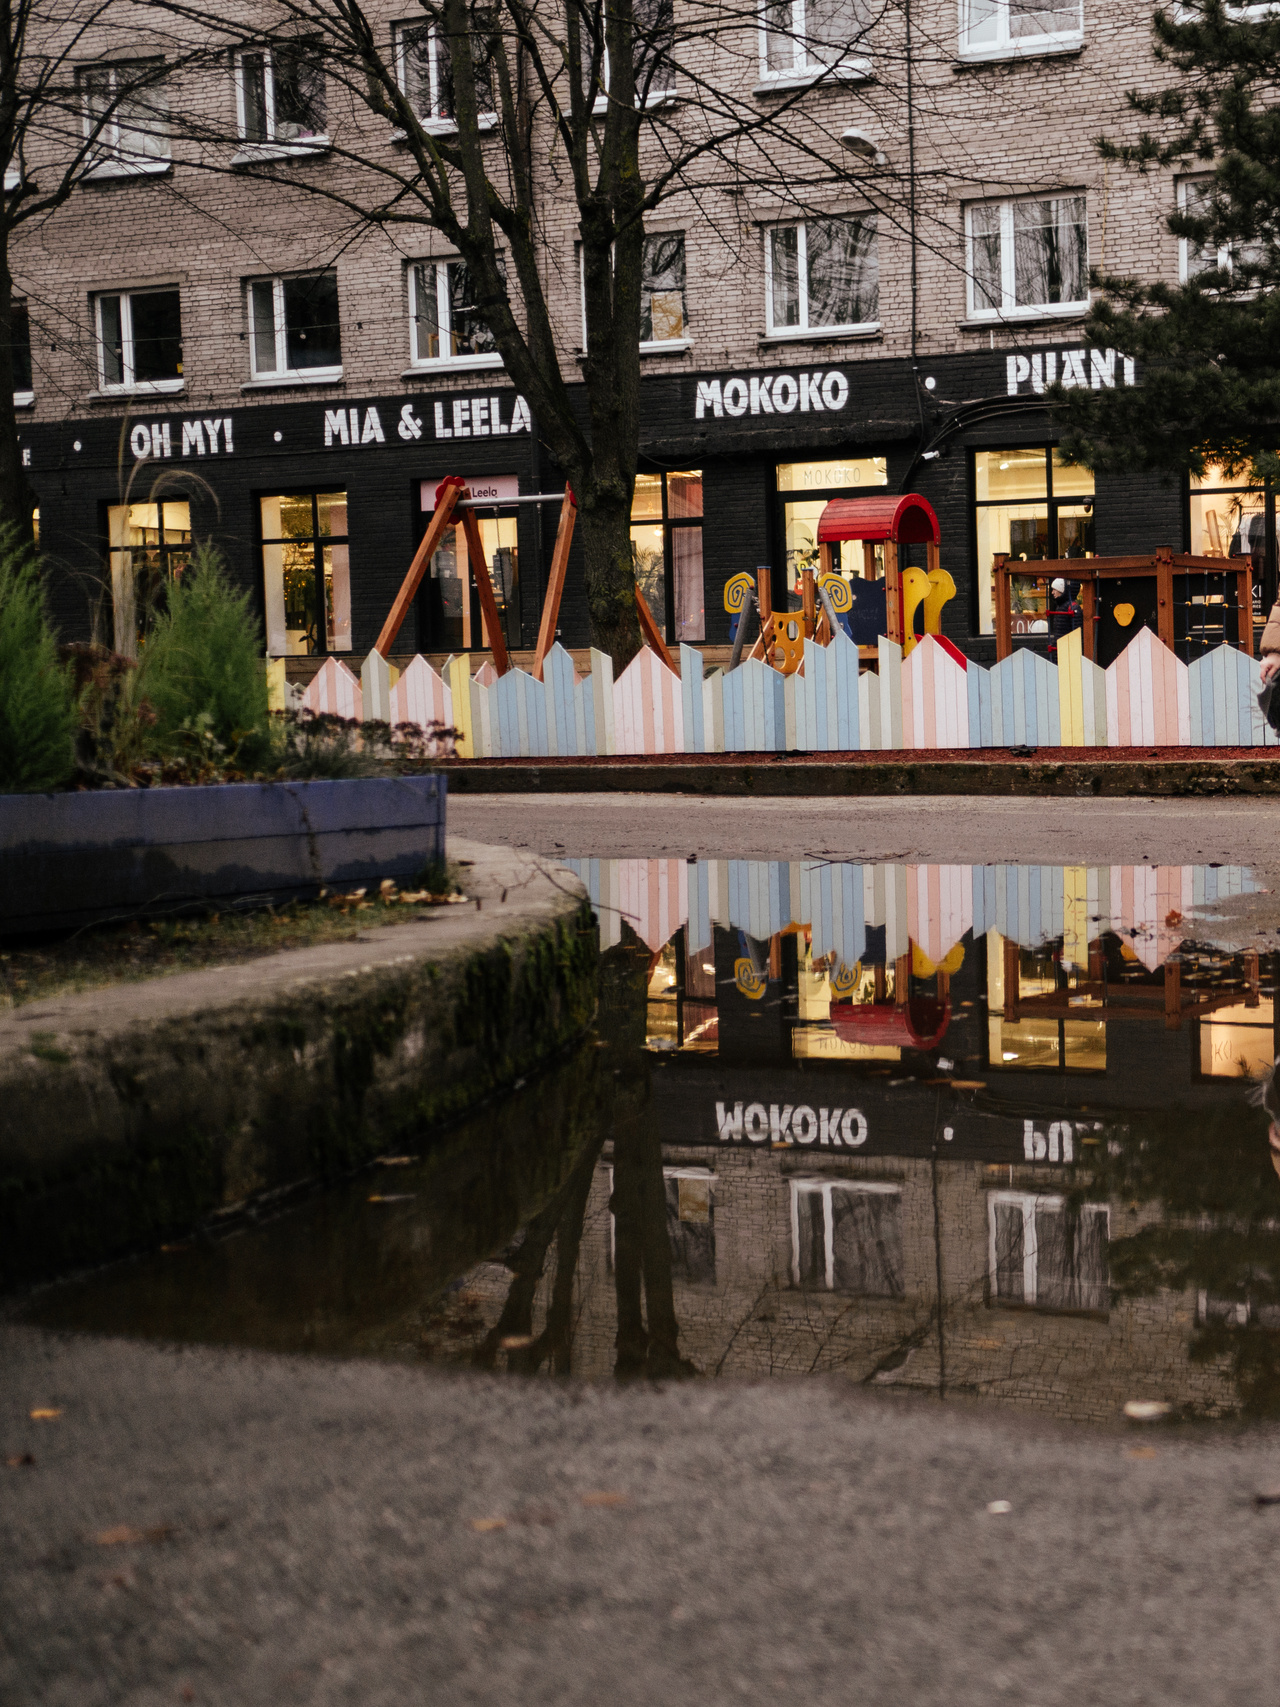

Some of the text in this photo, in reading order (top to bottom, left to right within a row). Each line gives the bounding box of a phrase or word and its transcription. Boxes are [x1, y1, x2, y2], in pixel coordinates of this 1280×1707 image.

[695, 370, 849, 419] MOKOKO
[130, 418, 234, 459] OH MY!
[324, 395, 532, 447] MIA & LEELA
[471, 486, 498, 498] Leela
[803, 467, 861, 486] MOKOKO
